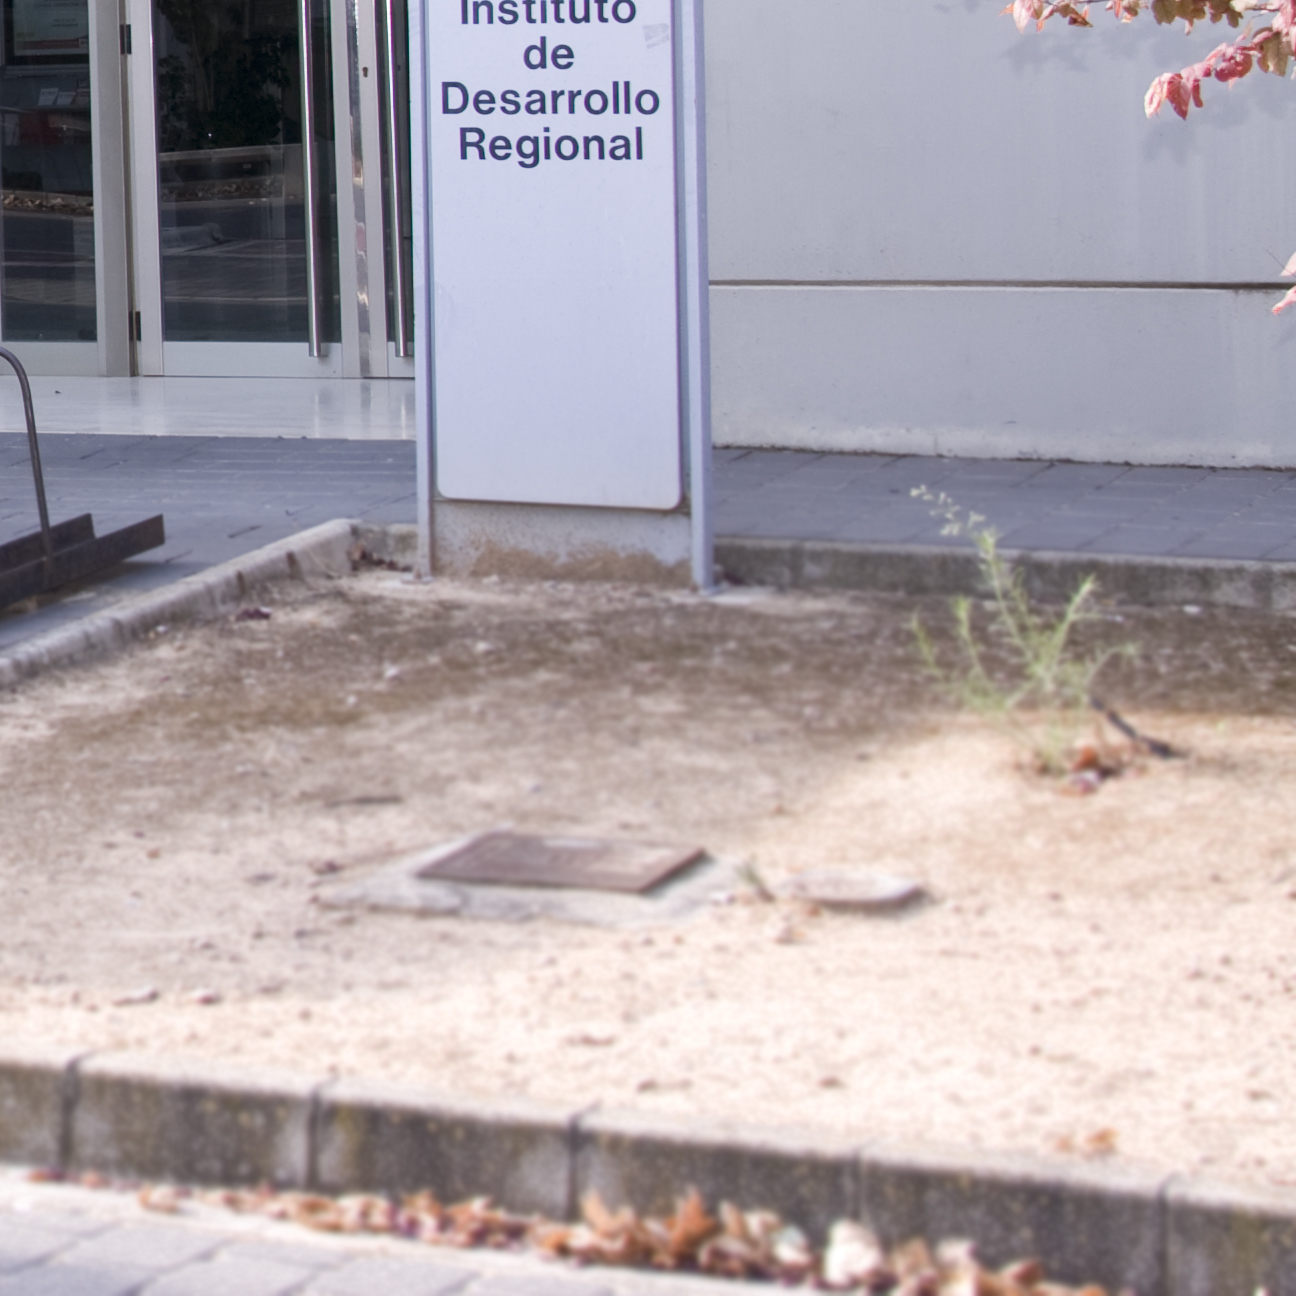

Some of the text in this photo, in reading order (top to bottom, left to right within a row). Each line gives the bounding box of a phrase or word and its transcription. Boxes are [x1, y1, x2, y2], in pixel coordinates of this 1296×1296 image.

[523, 36, 575, 70] de
[441, 80, 661, 116] Desarrollo
[459, 126, 644, 169] Regional
